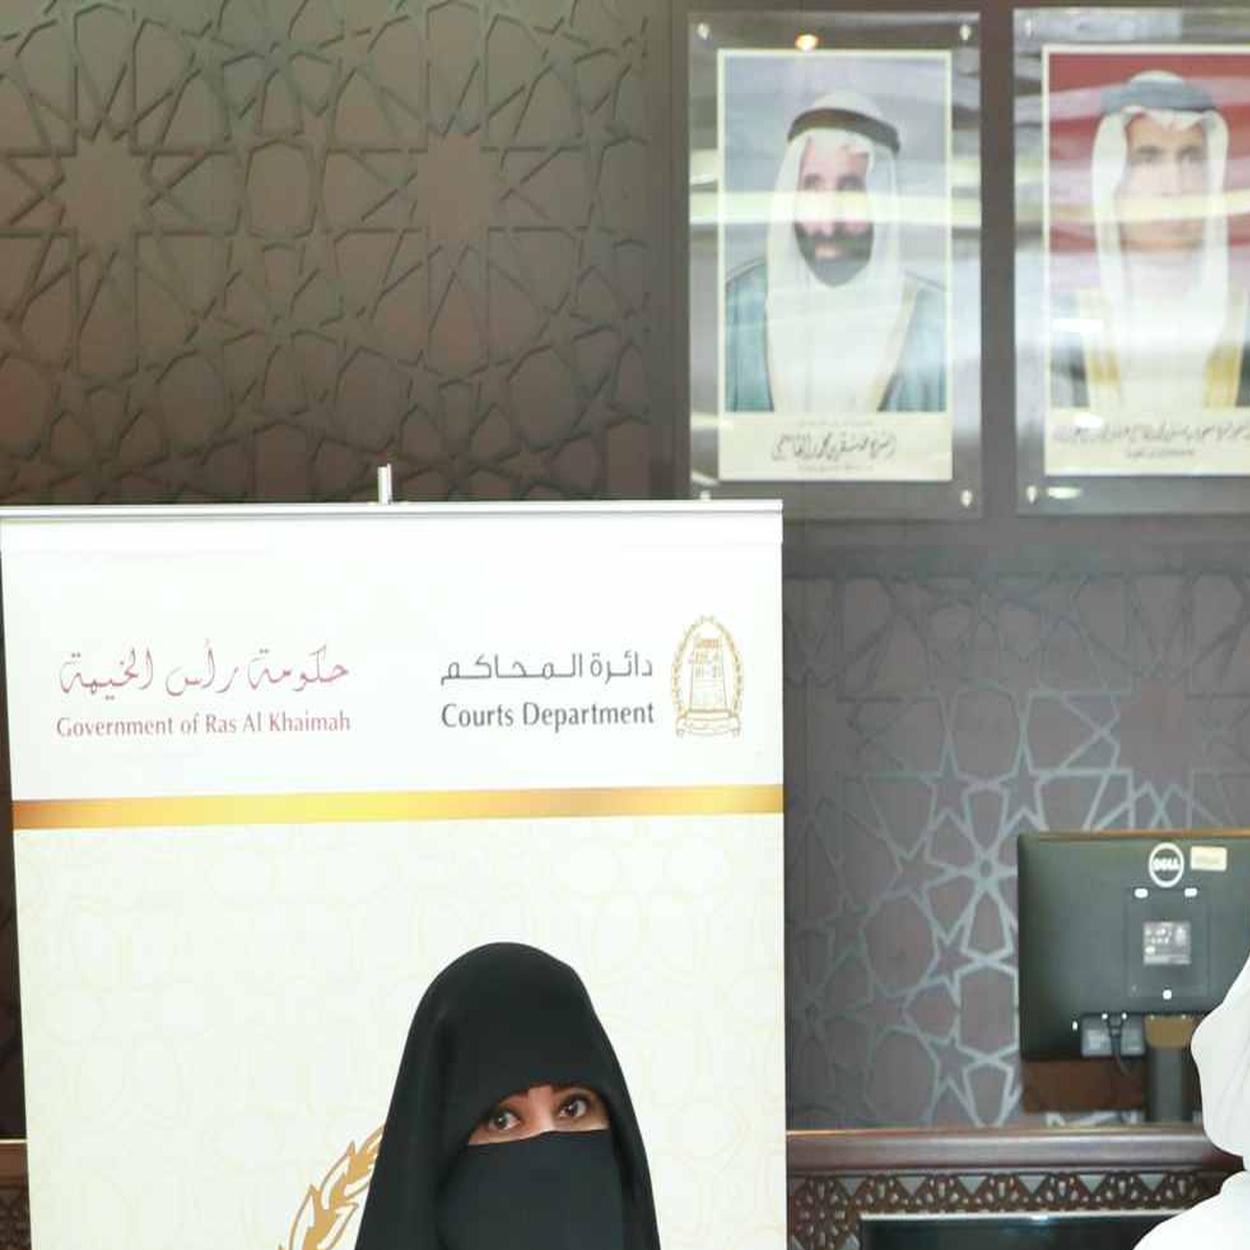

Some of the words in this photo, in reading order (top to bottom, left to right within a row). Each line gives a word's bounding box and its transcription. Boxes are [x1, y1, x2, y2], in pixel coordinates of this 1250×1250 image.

[440, 652, 583, 687] المحاكم
[589, 649, 653, 685] دائرة
[56, 716, 173, 737] Government
[180, 712, 200, 734] of
[205, 713, 237, 734] Ras
[242, 711, 262, 733] Al
[268, 709, 351, 732] Khaimah
[440, 703, 514, 728] Courts
[522, 701, 655, 734] Department
